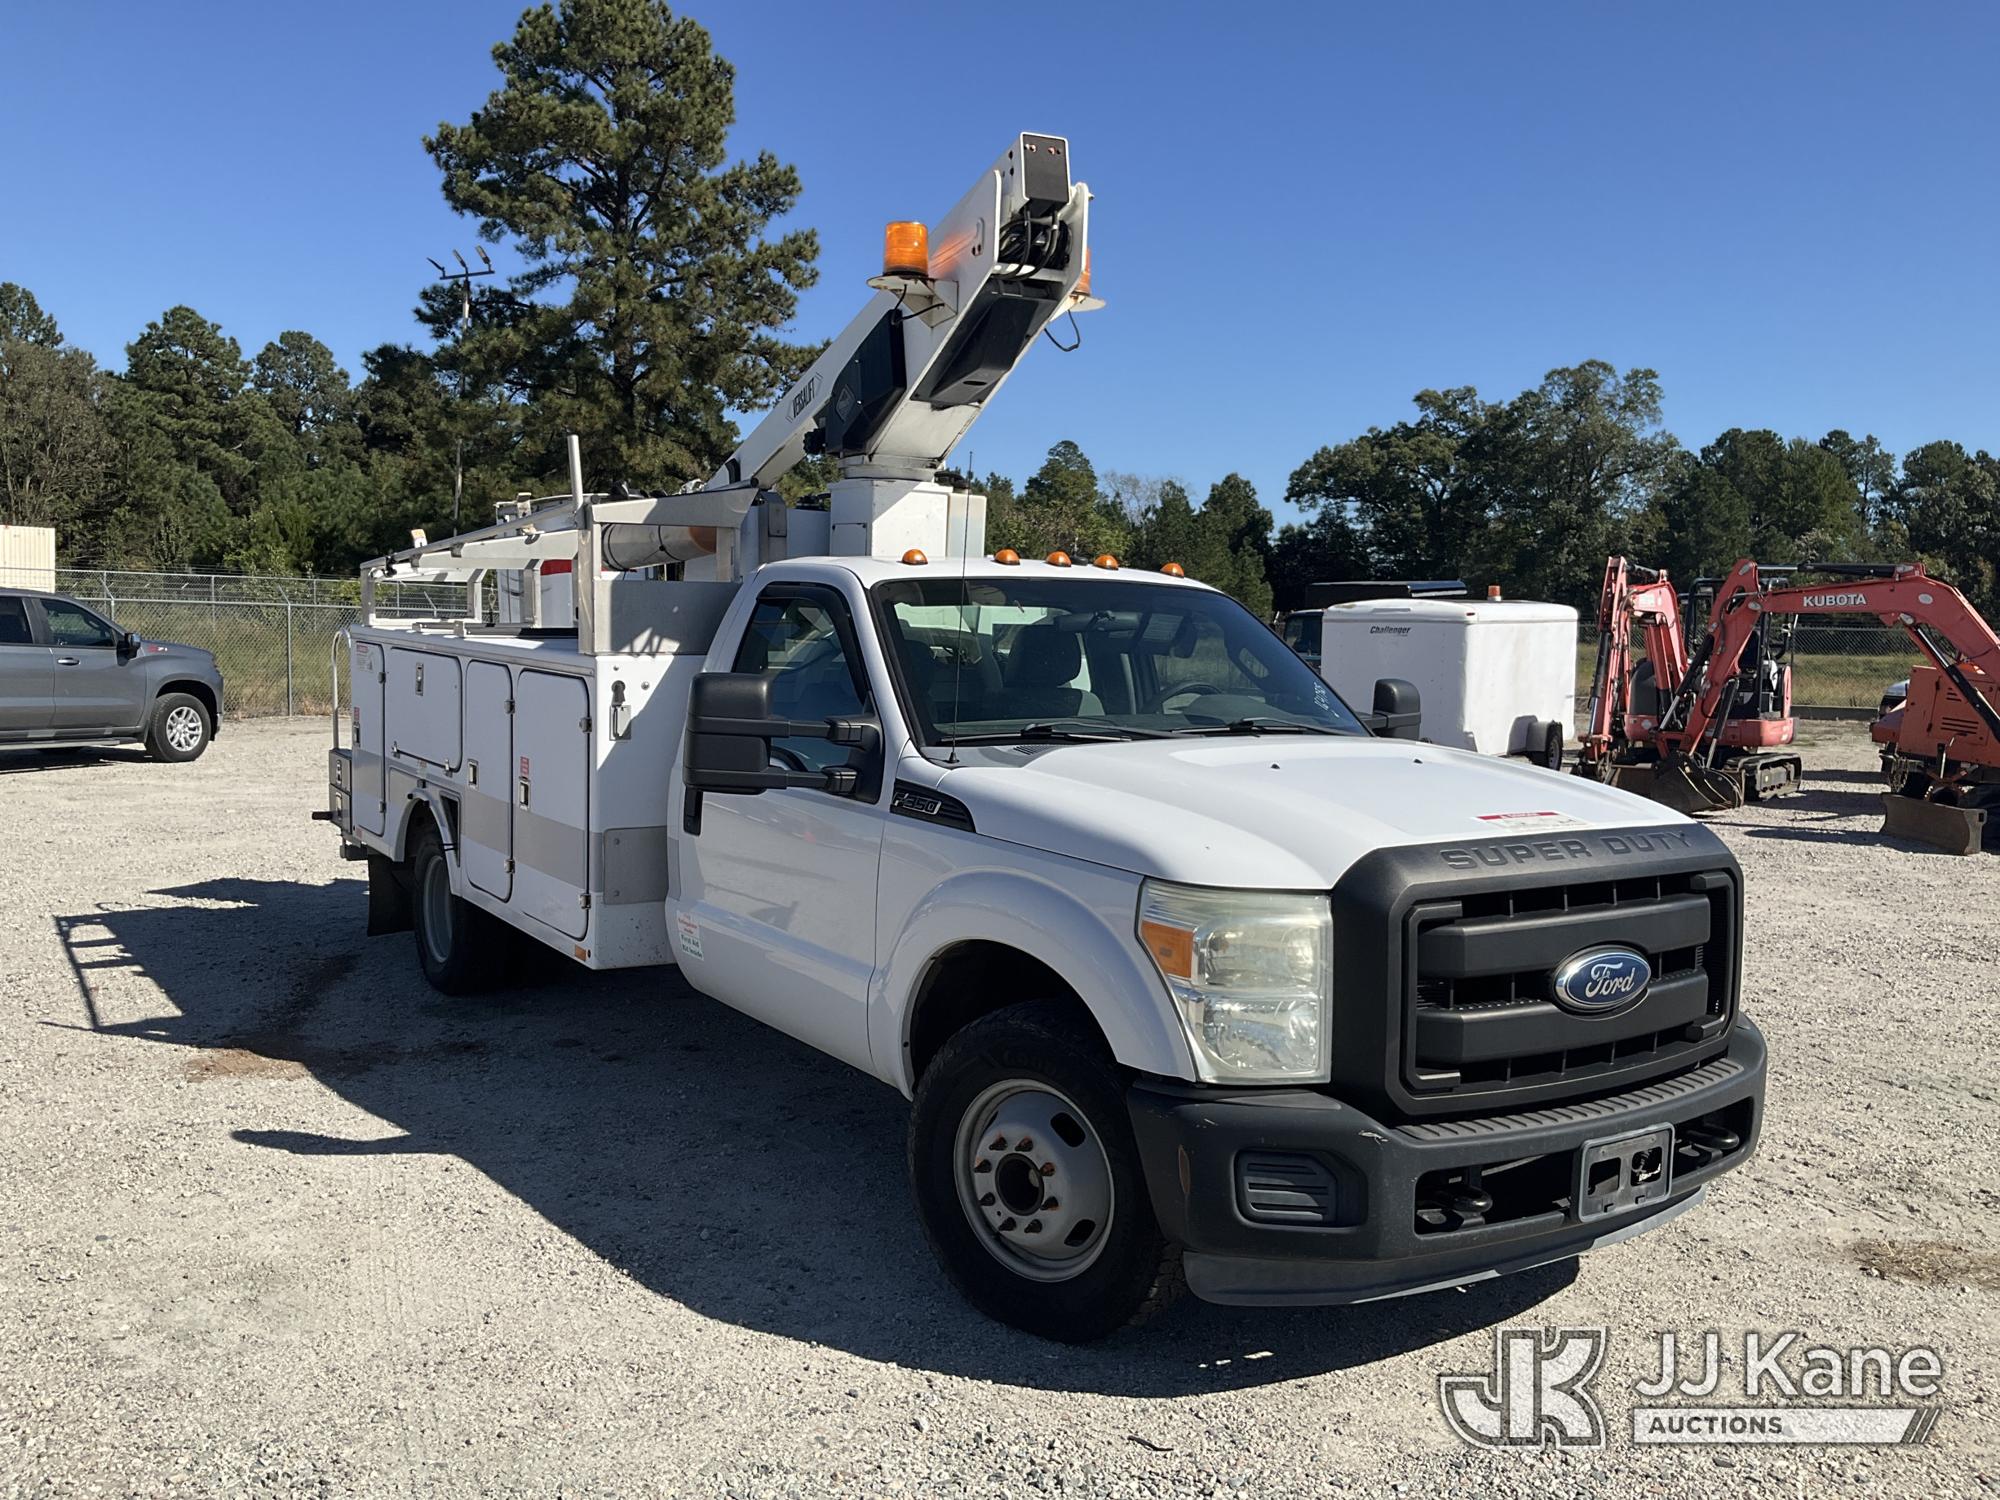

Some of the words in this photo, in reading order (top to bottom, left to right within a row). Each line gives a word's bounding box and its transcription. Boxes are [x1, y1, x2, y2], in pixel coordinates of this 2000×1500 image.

[1803, 593, 1867, 607] KUBOTA
[1370, 625, 1412, 636] Challenger
[1440, 839, 1593, 870] SUPER
[1600, 831, 1692, 855] DUTY
[1585, 962, 1636, 998] Ford
